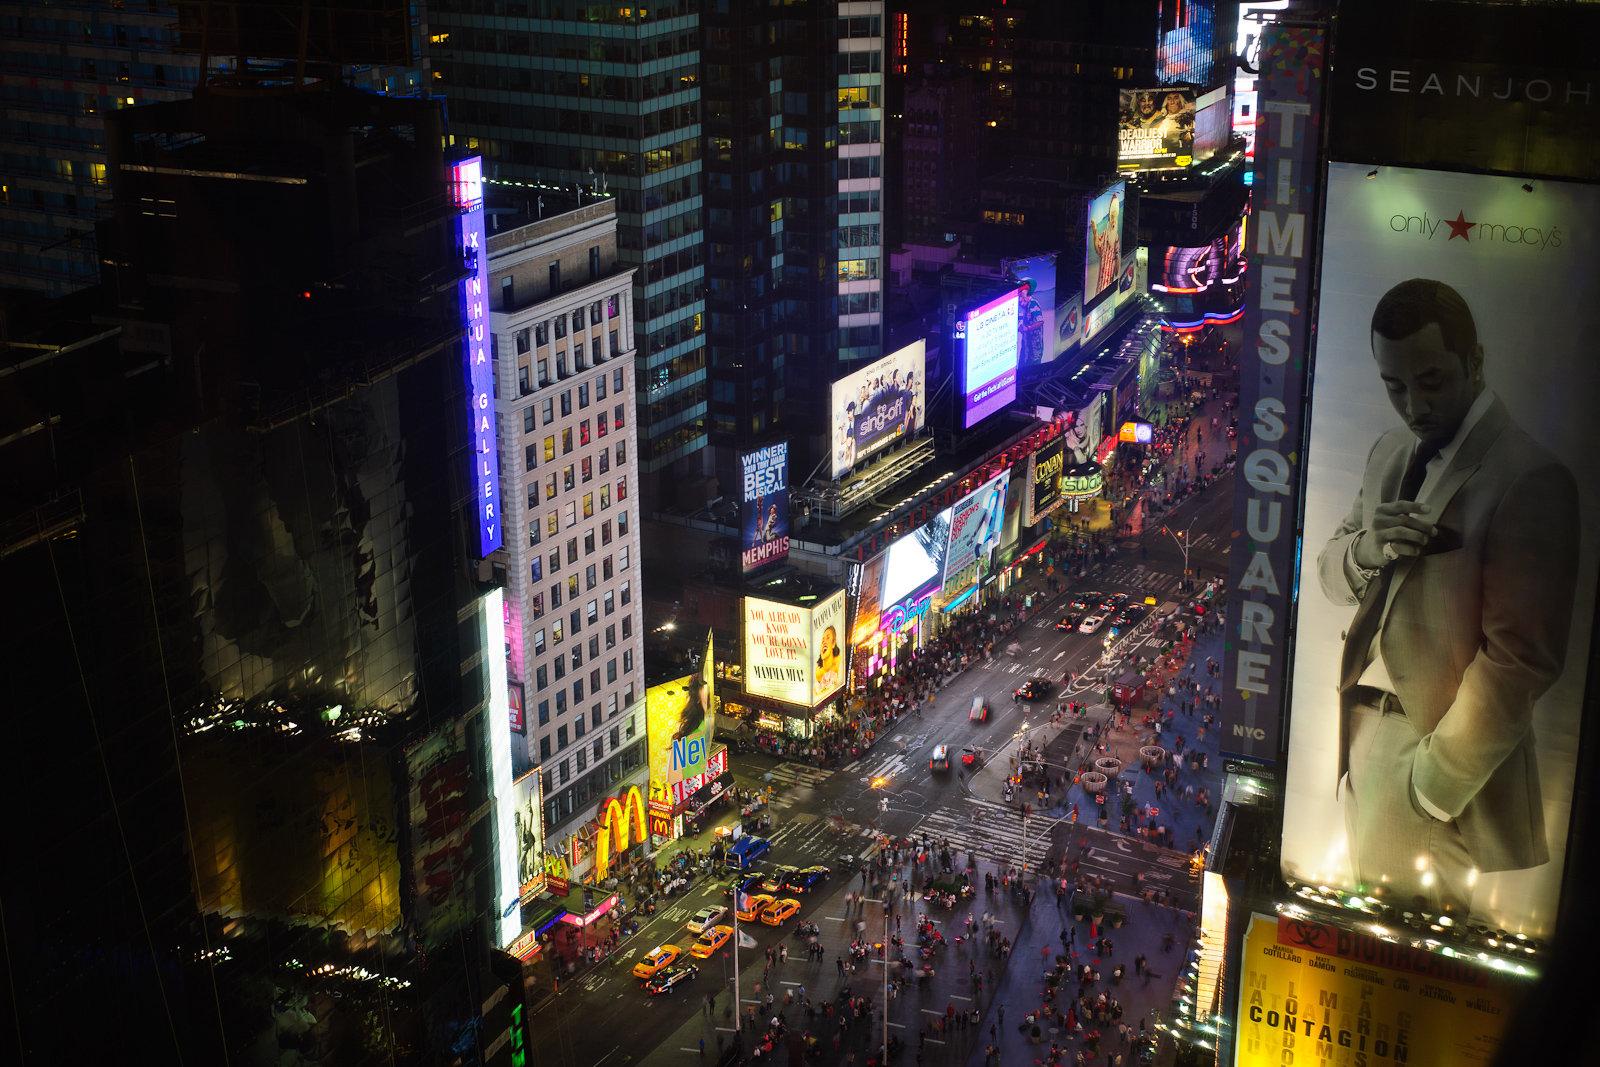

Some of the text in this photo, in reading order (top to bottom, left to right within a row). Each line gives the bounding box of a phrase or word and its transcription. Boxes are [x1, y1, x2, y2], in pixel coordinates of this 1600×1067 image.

[1120, 128, 1168, 140] DEADLIEST
[1120, 138, 1163, 152] WARRIOR
[1256, 100, 1311, 366] TIMES
[1389, 211, 1441, 241] only
[860, 396, 904, 436] sing-off
[741, 442, 787, 467] WINNER!
[479, 393, 495, 541] GALLERY
[744, 462, 785, 493] BEST
[1034, 450, 1063, 484] CONAN
[744, 480, 786, 503] MUSICAL
[742, 535, 790, 566] MEMPHIS
[1235, 397, 1291, 695] SQUARE
[751, 609, 801, 624] YOU ALREADY
[813, 609, 832, 630] MAMMA
[766, 623, 788, 634] KNOW
[752, 633, 807, 649] YOU'RE GONNA
[765, 646, 783, 659] LOVE
[754, 665, 805, 682] MAMMA MIA!
[1232, 723, 1266, 741] NYC
[1263, 947, 1303, 964] COTILLARD
[1308, 959, 1337, 973] DAMON
[1249, 1004, 1409, 1064] CONTAGION
